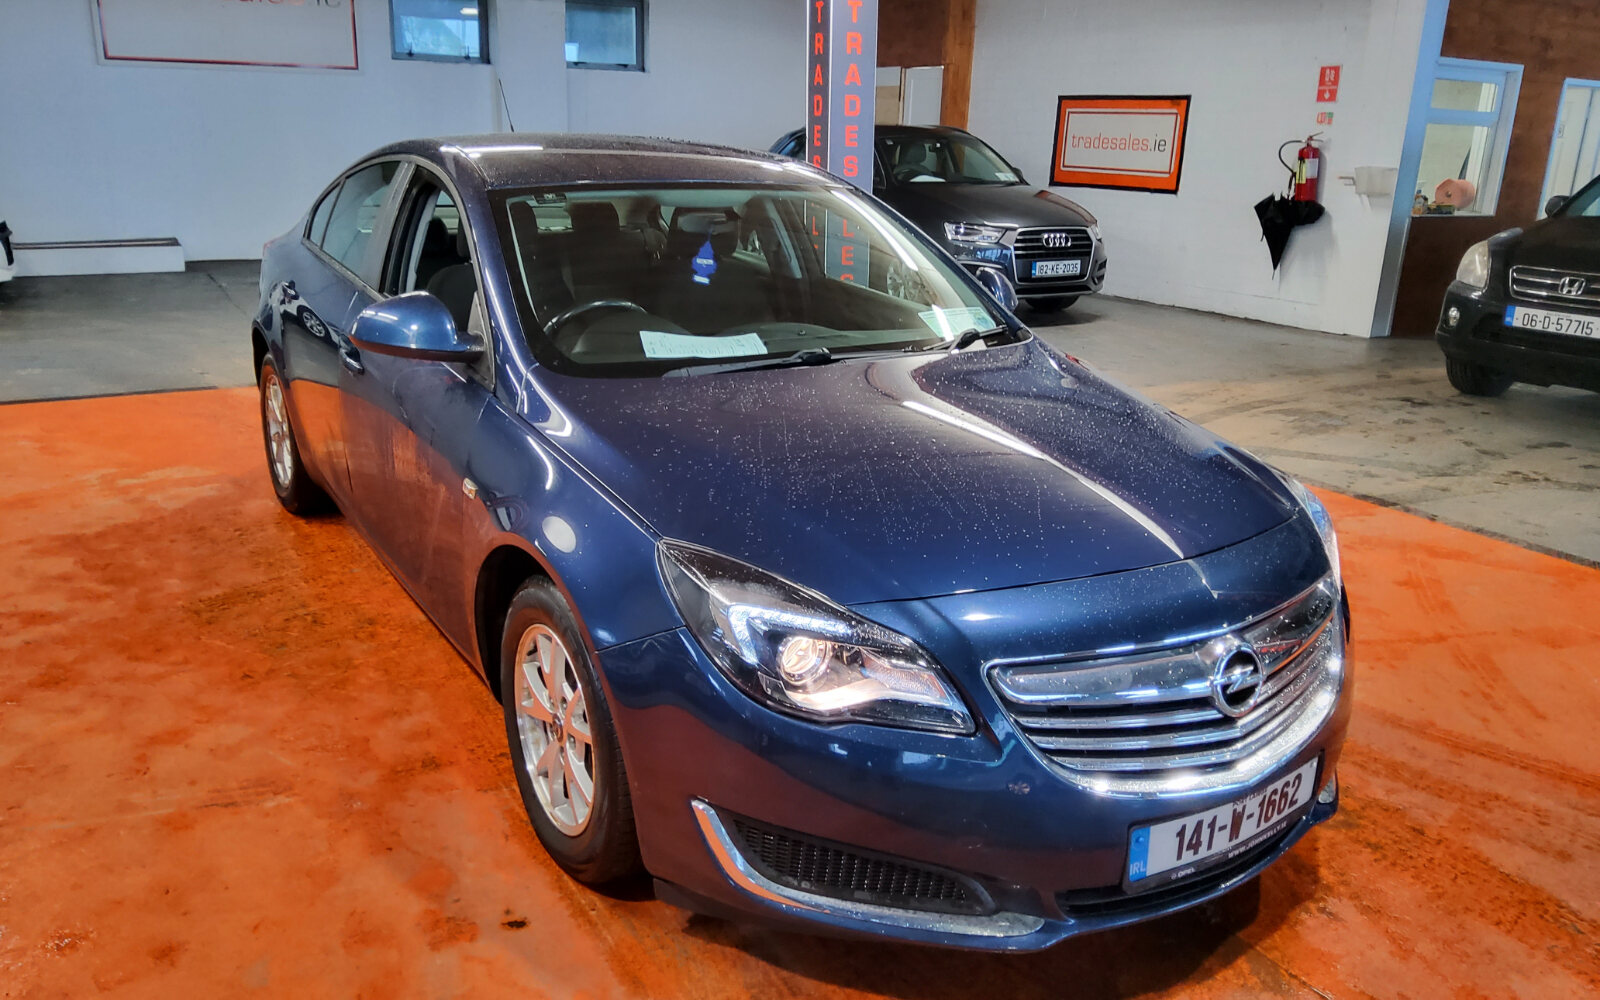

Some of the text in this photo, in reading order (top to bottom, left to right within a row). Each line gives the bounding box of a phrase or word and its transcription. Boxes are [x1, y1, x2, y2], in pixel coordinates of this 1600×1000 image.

[843, 0, 863, 177] TRADES
[1071, 131, 1167, 152] tradesales.ie
[1037, 263, 1079, 274] 182-KE-2035
[1521, 312, 1595, 336] 06-D-57715
[1175, 773, 1303, 861] 141-W-1662
[1129, 860, 1146, 876] IRL
